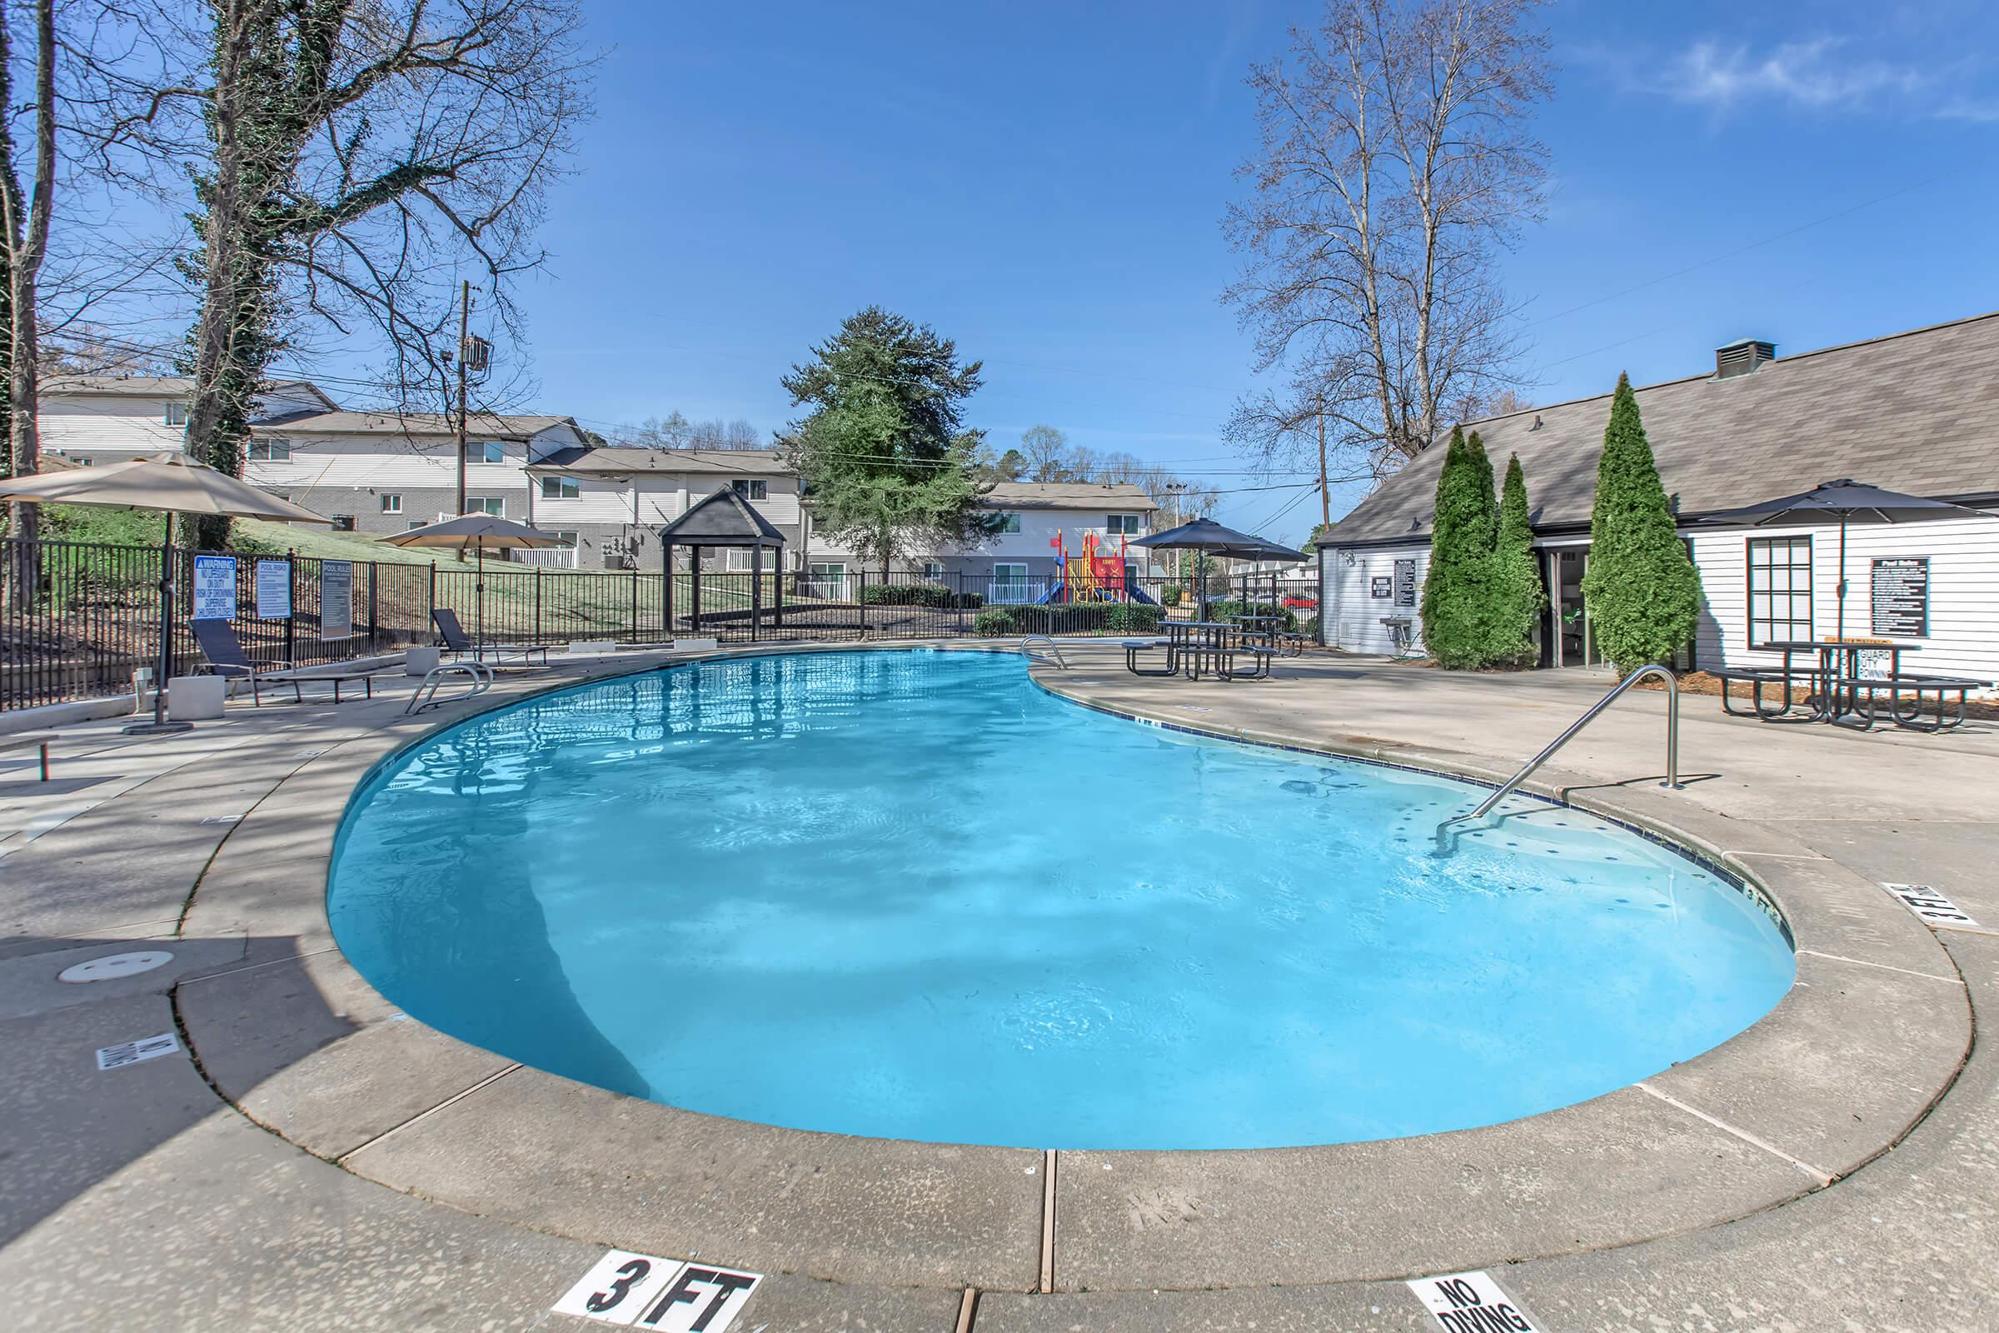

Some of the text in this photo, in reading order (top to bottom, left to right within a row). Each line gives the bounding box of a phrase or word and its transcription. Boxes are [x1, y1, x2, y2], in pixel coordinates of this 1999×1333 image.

[203, 560, 234, 570] WARNING
[324, 564, 351, 573] POOL RULES
[1756, 896, 1770, 913] FT
[1900, 894, 1969, 921] 3 FT
[586, 1258, 757, 1333] 3 FT
[1434, 1278, 1482, 1308] NO
[1437, 1303, 1532, 1333] DIVING
